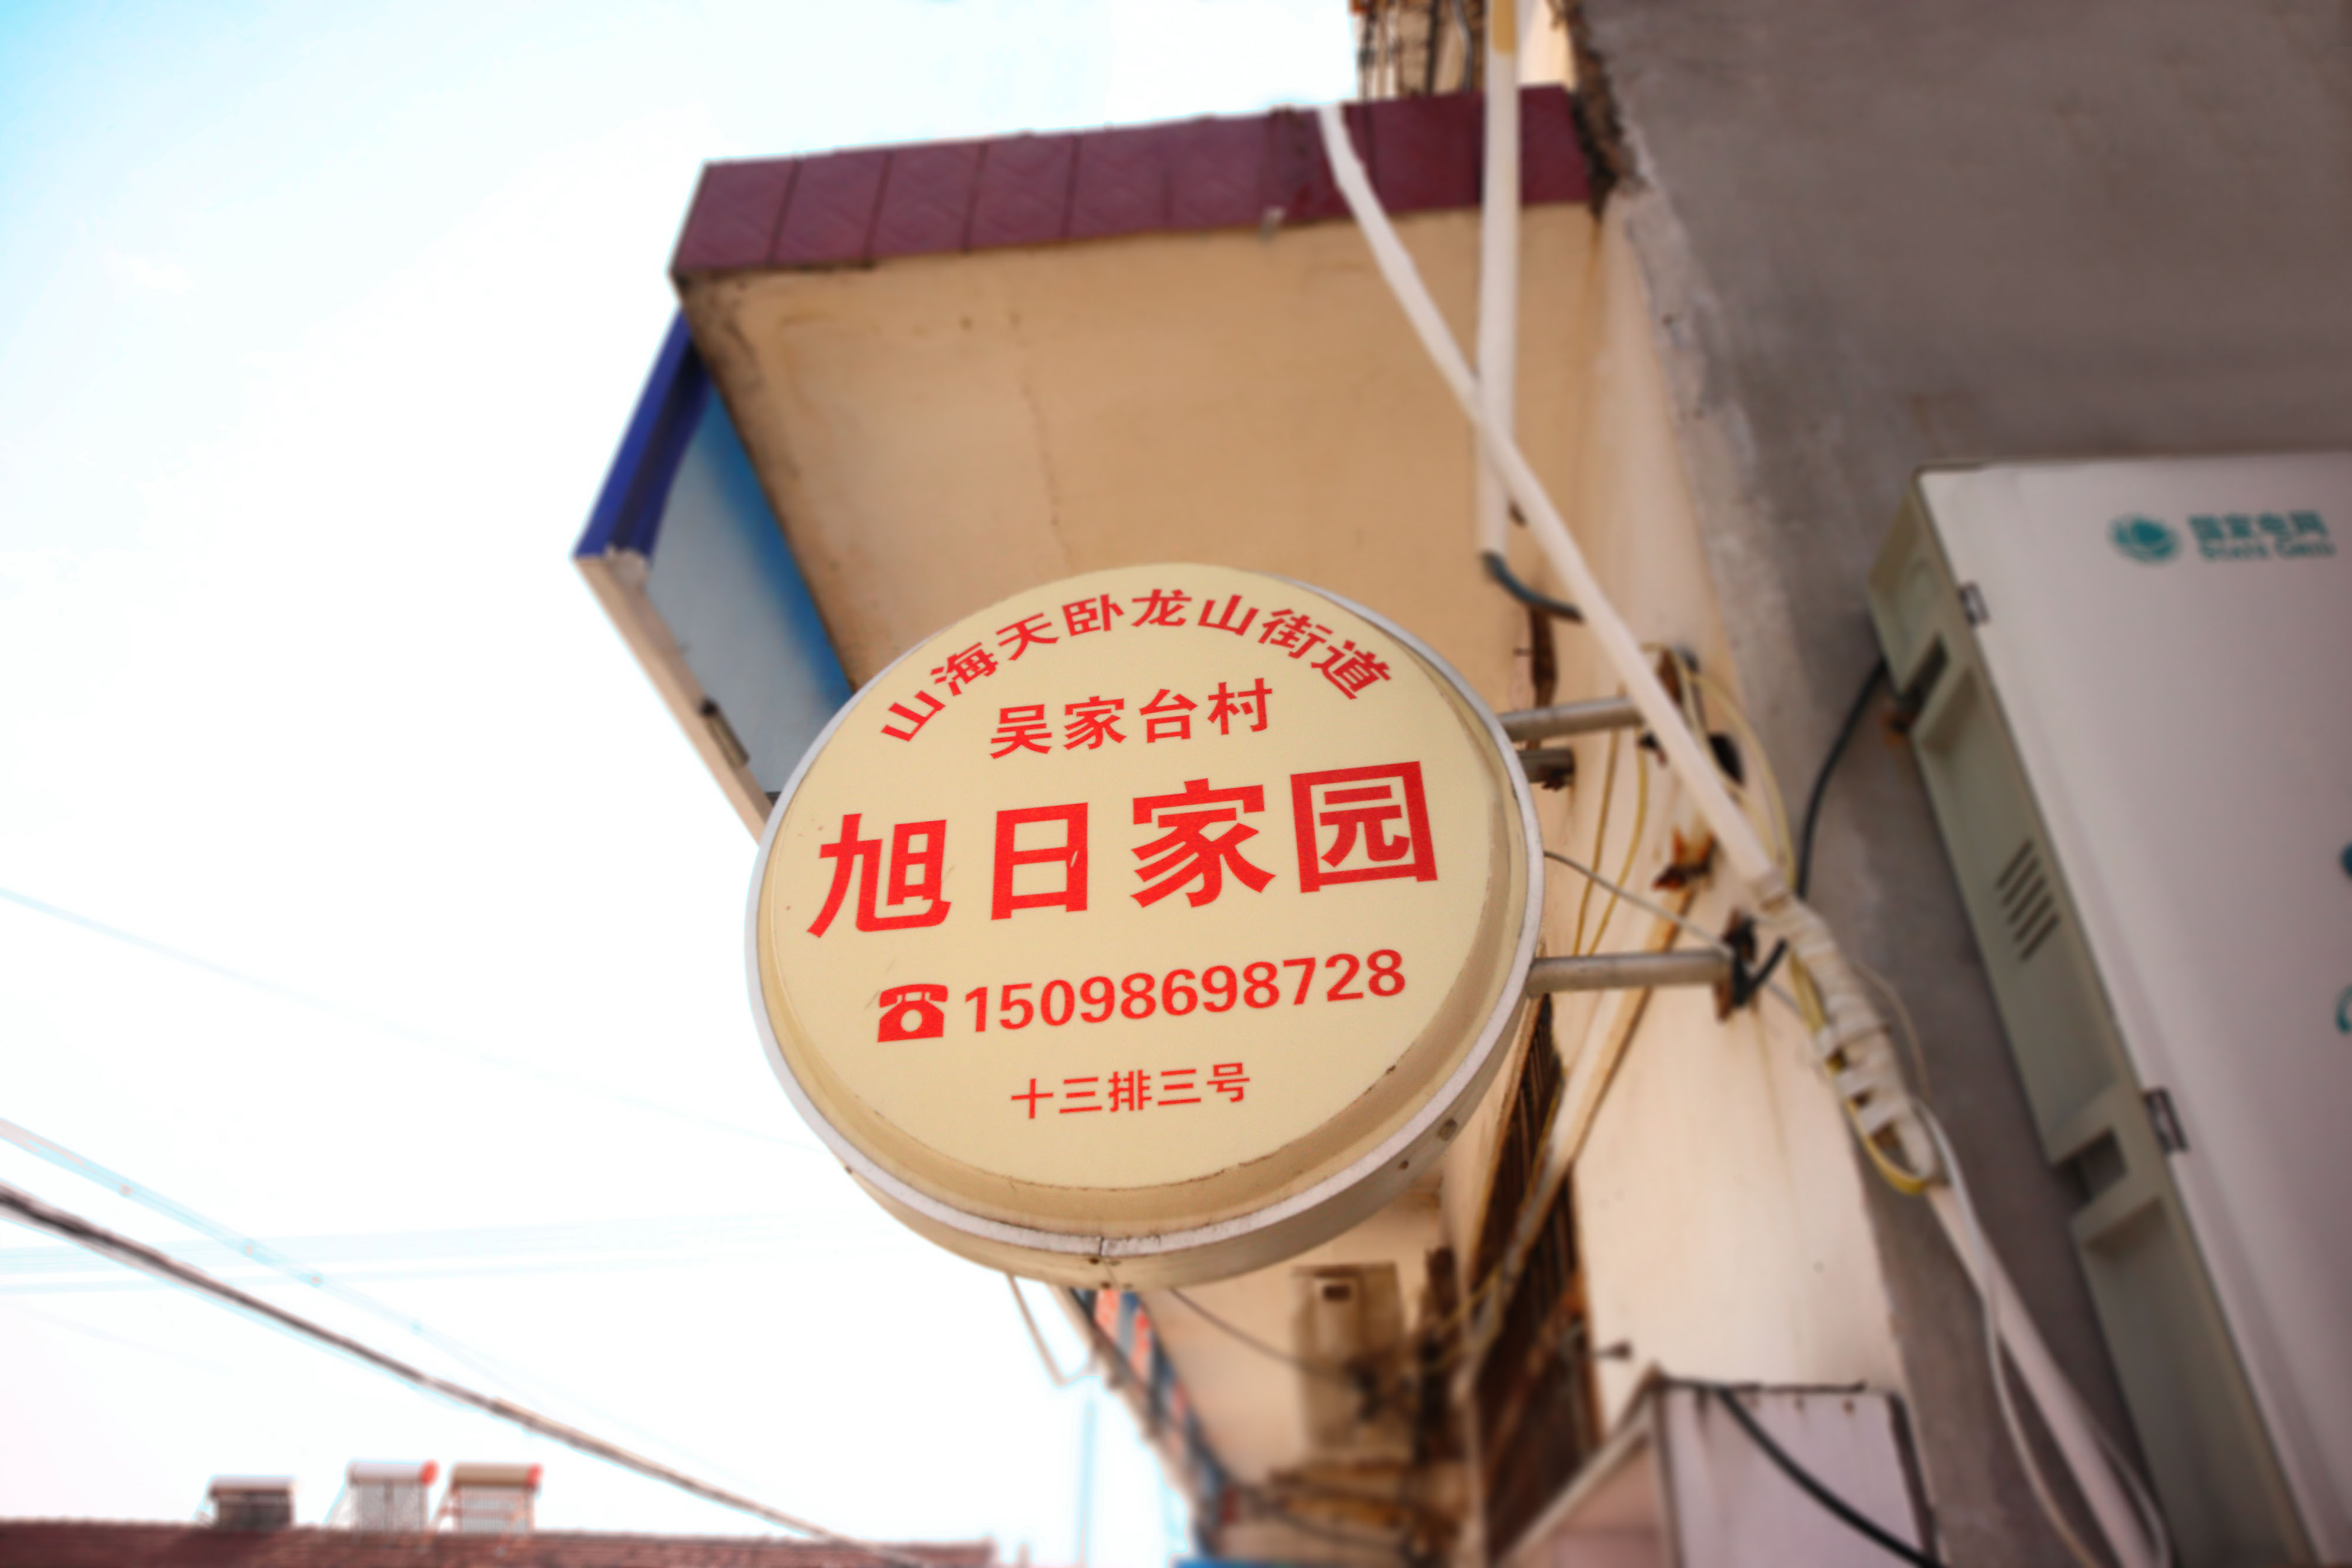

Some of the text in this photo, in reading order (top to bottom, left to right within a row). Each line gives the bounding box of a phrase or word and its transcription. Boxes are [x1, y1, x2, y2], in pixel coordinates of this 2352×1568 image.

[881, 589, 1391, 742] 山海天卧龙山街道
[990, 678, 1273, 760] 吴家台村
[807, 760, 1438, 938] 旭日家园
[964, 949, 1406, 1033] 15098698728
[1010, 1062, 1251, 1120] 十三排三号
